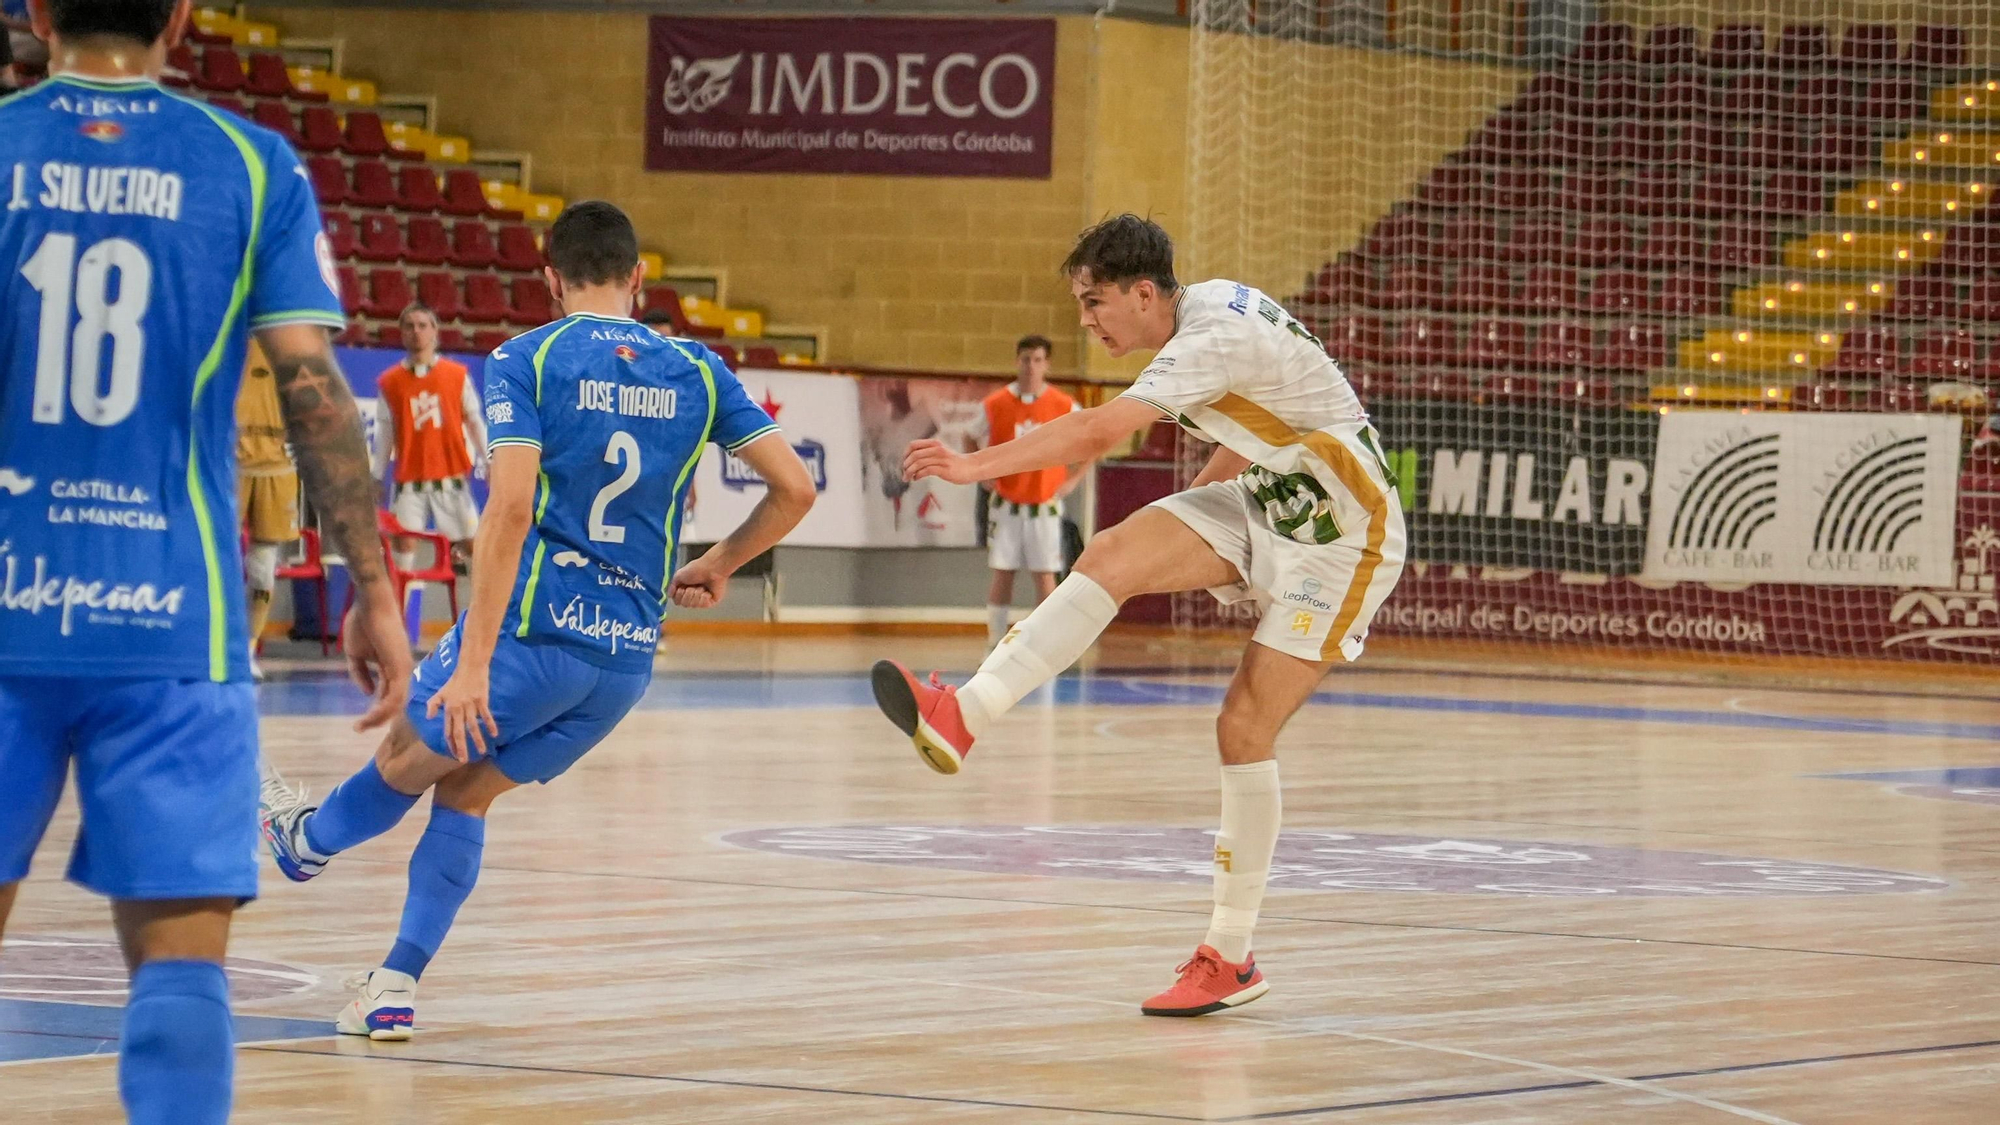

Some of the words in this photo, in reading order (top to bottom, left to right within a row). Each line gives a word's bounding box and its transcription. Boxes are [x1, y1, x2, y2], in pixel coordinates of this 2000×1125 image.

[748, 51, 1040, 119] IMDECO
[663, 126, 737, 148] Instituto
[740, 128, 830, 153] Municipal
[835, 131, 858, 150] de
[863, 129, 949, 155] Deportes
[952, 130, 1034, 153] Córdoba
[40, 161, 183, 222] SILVEIRA
[20, 232, 152, 426] 18
[576, 379, 616, 414] JOSE
[618, 384, 677, 420] MARIO
[588, 430, 641, 544] 2
[1428, 449, 1649, 526] MILAR
[47, 505, 75, 523] LA
[78, 507, 167, 531] MANCHA
[598, 574, 613, 585] LA
[1733, 551, 1774, 569] BAR
[1878, 554, 1919, 572] BAR
[0, 539, 186, 637] ldepeñas
[1283, 590, 1332, 611] LeoProex
[1372, 602, 1461, 633] nicipal
[1470, 605, 1506, 632] de
[1513, 606, 1640, 639] Deportes
[1647, 609, 1766, 643] Córdoba
